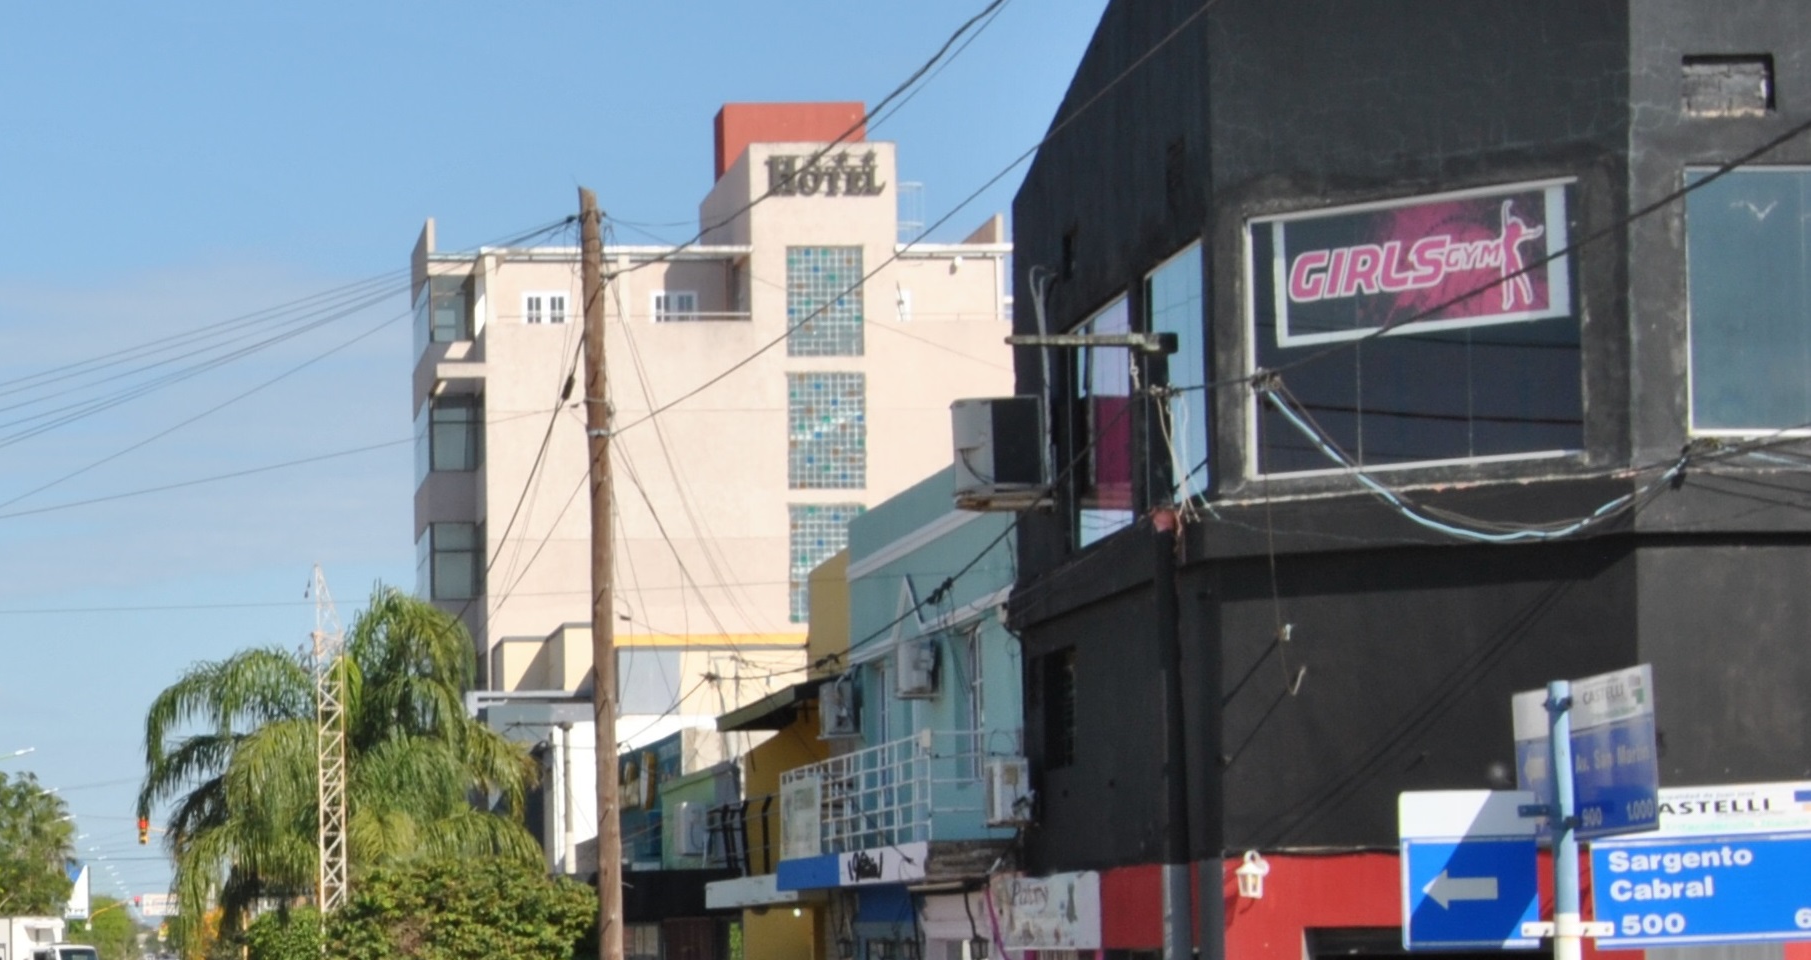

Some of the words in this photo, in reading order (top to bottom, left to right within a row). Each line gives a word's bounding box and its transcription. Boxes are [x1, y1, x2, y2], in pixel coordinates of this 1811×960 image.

[764, 153, 887, 197] HOTEL
[1289, 235, 1451, 302] GIRLS
[1443, 238, 1502, 271] GYM
[1581, 805, 1603, 828] 900
[1659, 797, 1771, 816] ASTELLI
[1608, 845, 1754, 875] Sargento
[1609, 875, 1715, 902] Cabral
[1621, 912, 1686, 936] 500
